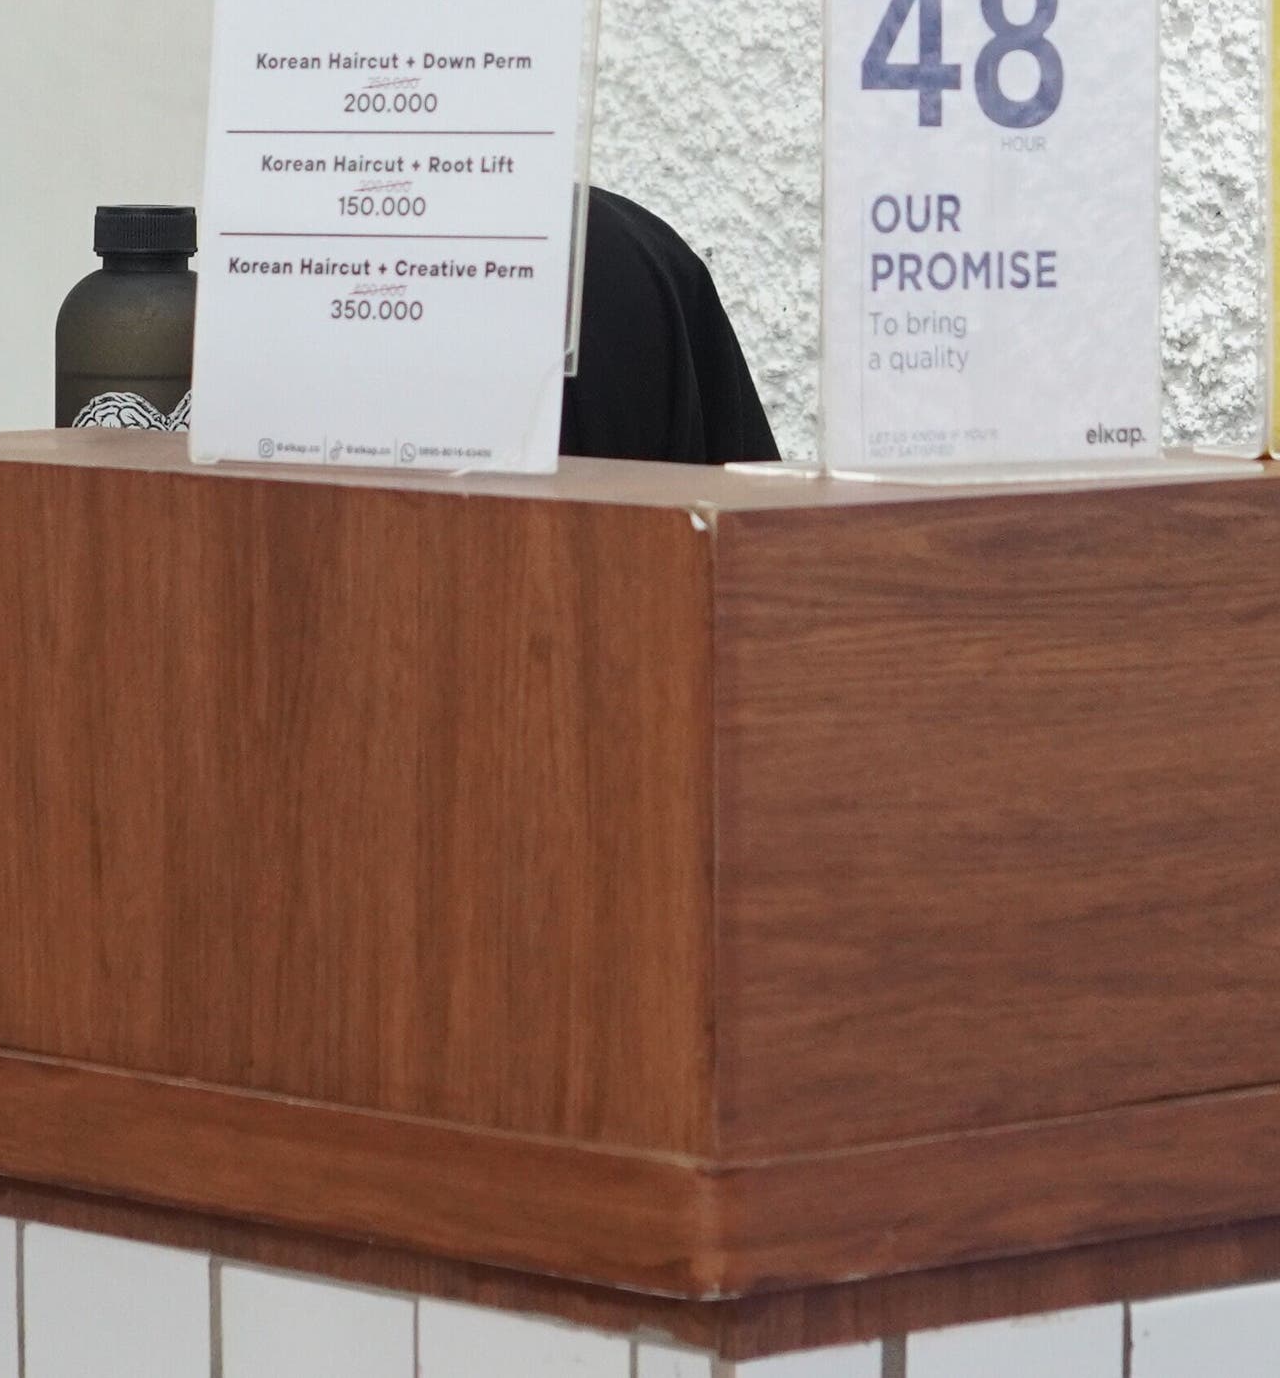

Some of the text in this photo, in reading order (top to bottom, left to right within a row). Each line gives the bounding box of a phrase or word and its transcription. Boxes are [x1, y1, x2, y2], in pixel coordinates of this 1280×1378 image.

[256, 52, 532, 71] Korean Haircut + Down Perm
[343, 93, 438, 113] 200.000
[1001, 135, 1048, 153] HOUR
[261, 154, 515, 173] Korean Haircut + Root Lift
[337, 196, 426, 217] 150.000
[870, 193, 962, 235] OUR
[228, 257, 534, 278] Korean Haircut + Creative Perm
[870, 249, 1058, 293] PROMISE
[330, 299, 424, 321] 350.000
[868, 310, 968, 340] To bring
[868, 342, 969, 373] a quality
